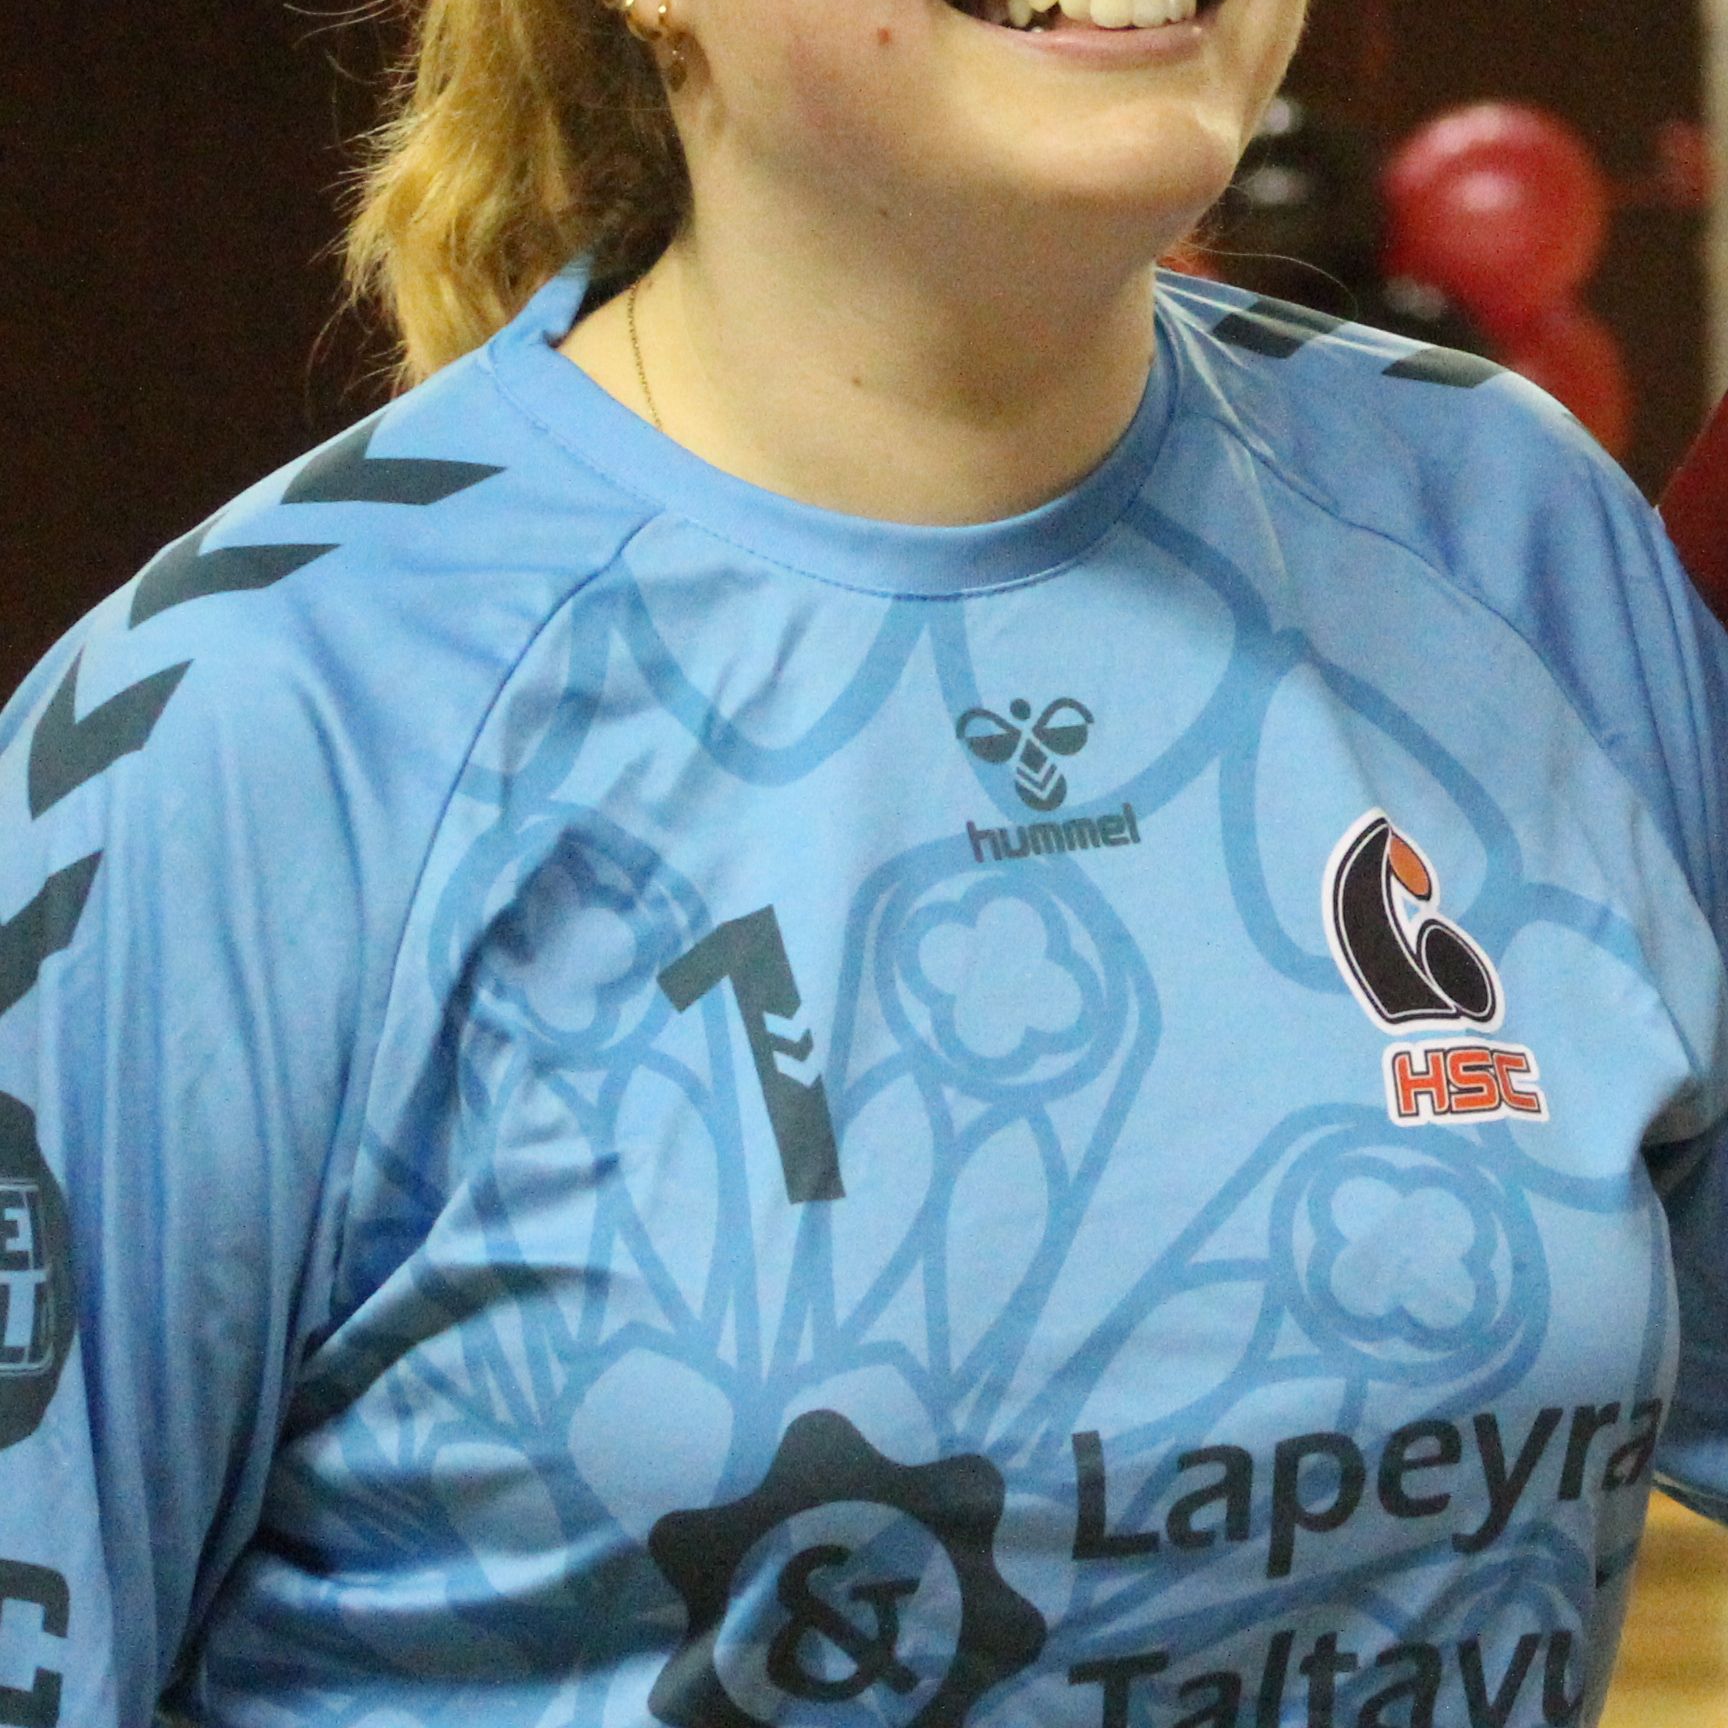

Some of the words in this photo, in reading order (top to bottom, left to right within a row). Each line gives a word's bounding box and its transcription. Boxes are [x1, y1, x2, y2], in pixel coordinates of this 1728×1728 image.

[966, 802, 1141, 864] hummel
[656, 904, 847, 1204] 1
[1392, 1046, 1541, 1118] HSC
[1071, 1398, 1664, 1580] Lapeyra
[1068, 1626, 1598, 1728] Taltavu
